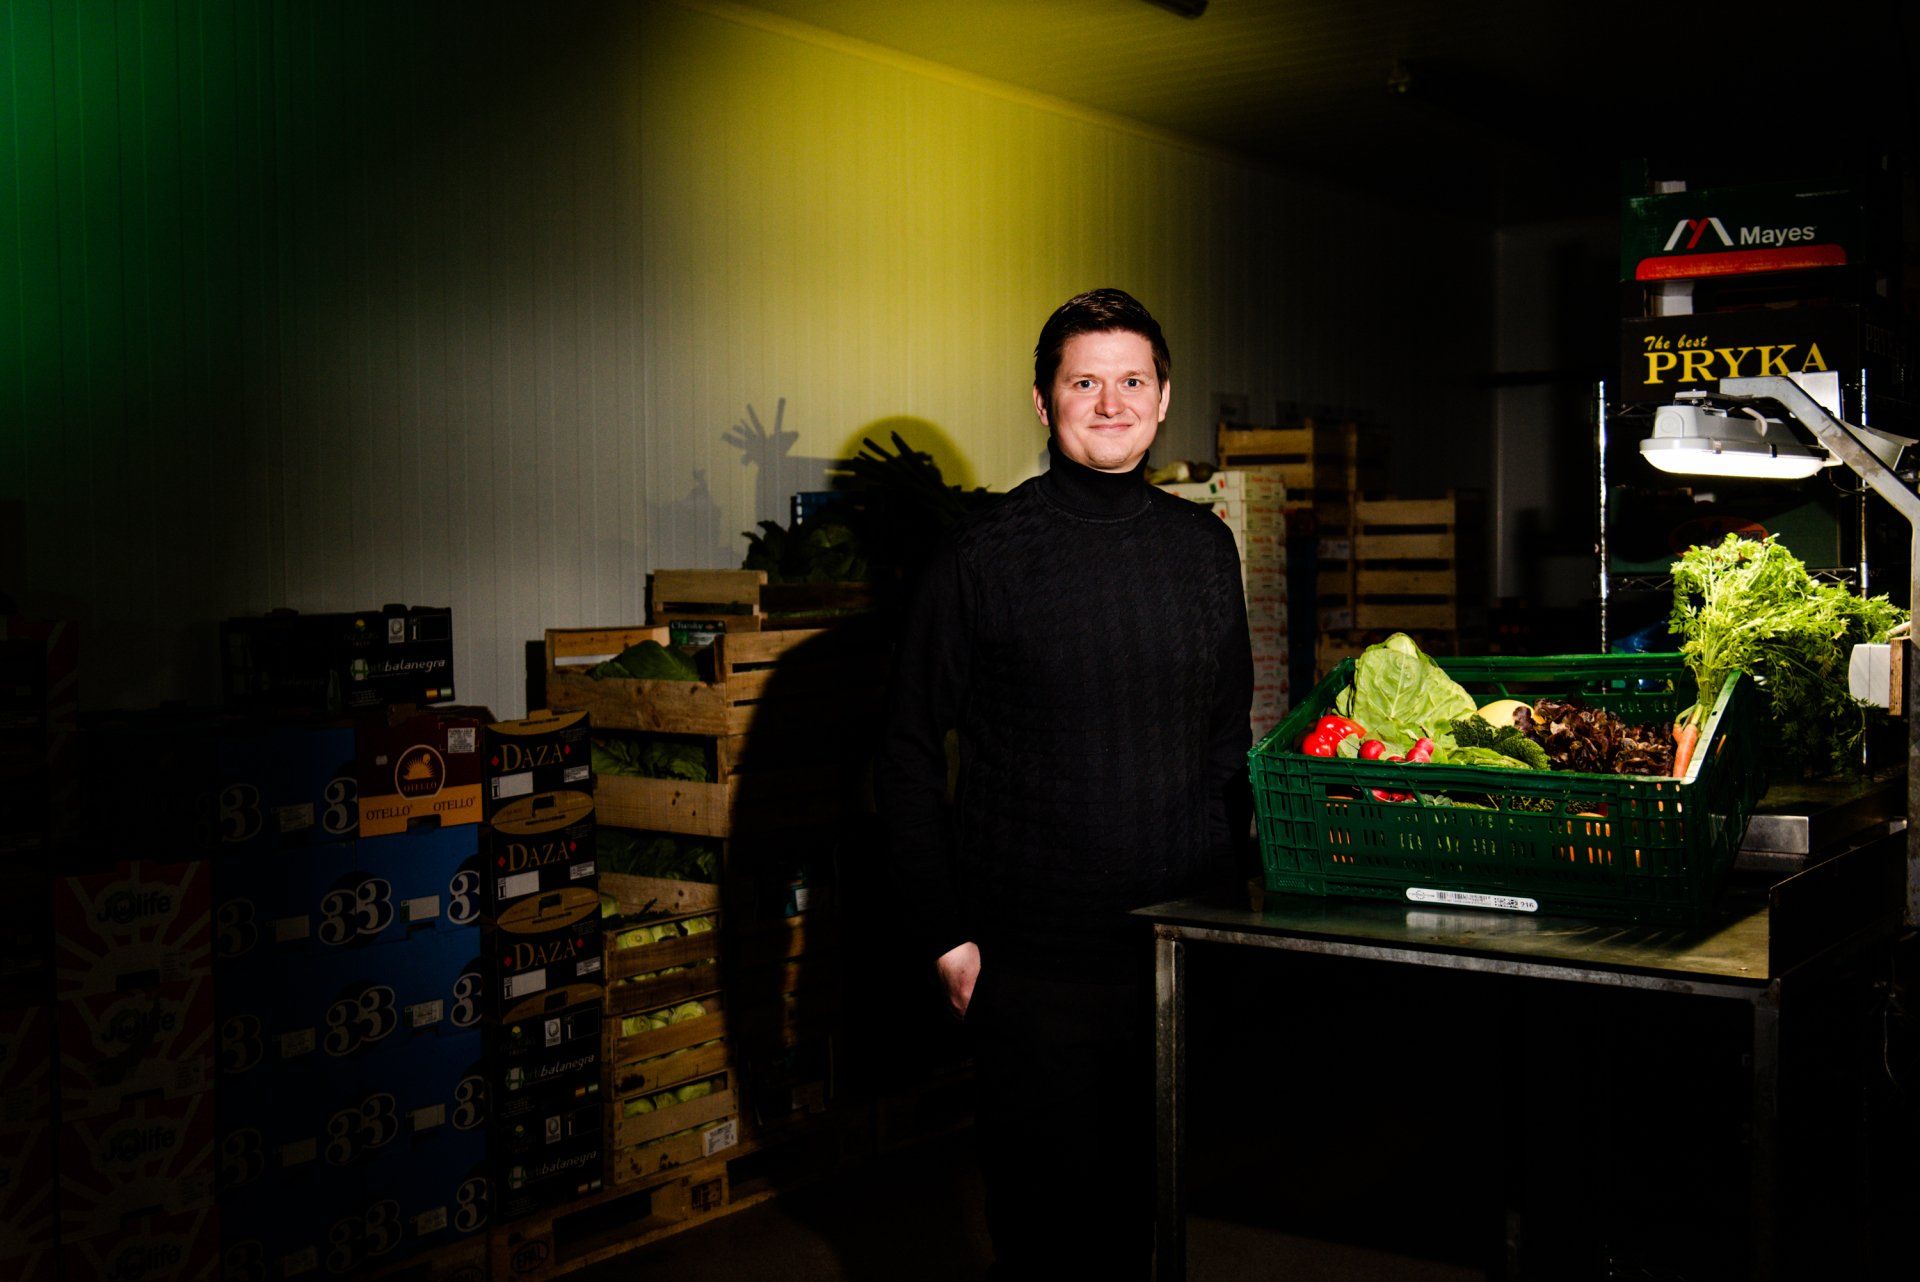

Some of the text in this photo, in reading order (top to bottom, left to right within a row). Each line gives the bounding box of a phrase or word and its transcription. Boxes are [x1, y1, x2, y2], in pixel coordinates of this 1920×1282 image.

[1740, 226, 1815, 246] Mayes
[1643, 334, 1708, 350] The best
[1643, 342, 1828, 385] PRYKA
[500, 743, 565, 773] DAZA
[403, 782, 437, 794] OTELLO
[366, 805, 410, 821] OTELLO
[434, 798, 474, 812] OTELLO
[506, 840, 570, 872] DAZA
[514, 936, 577, 972] DAZA
